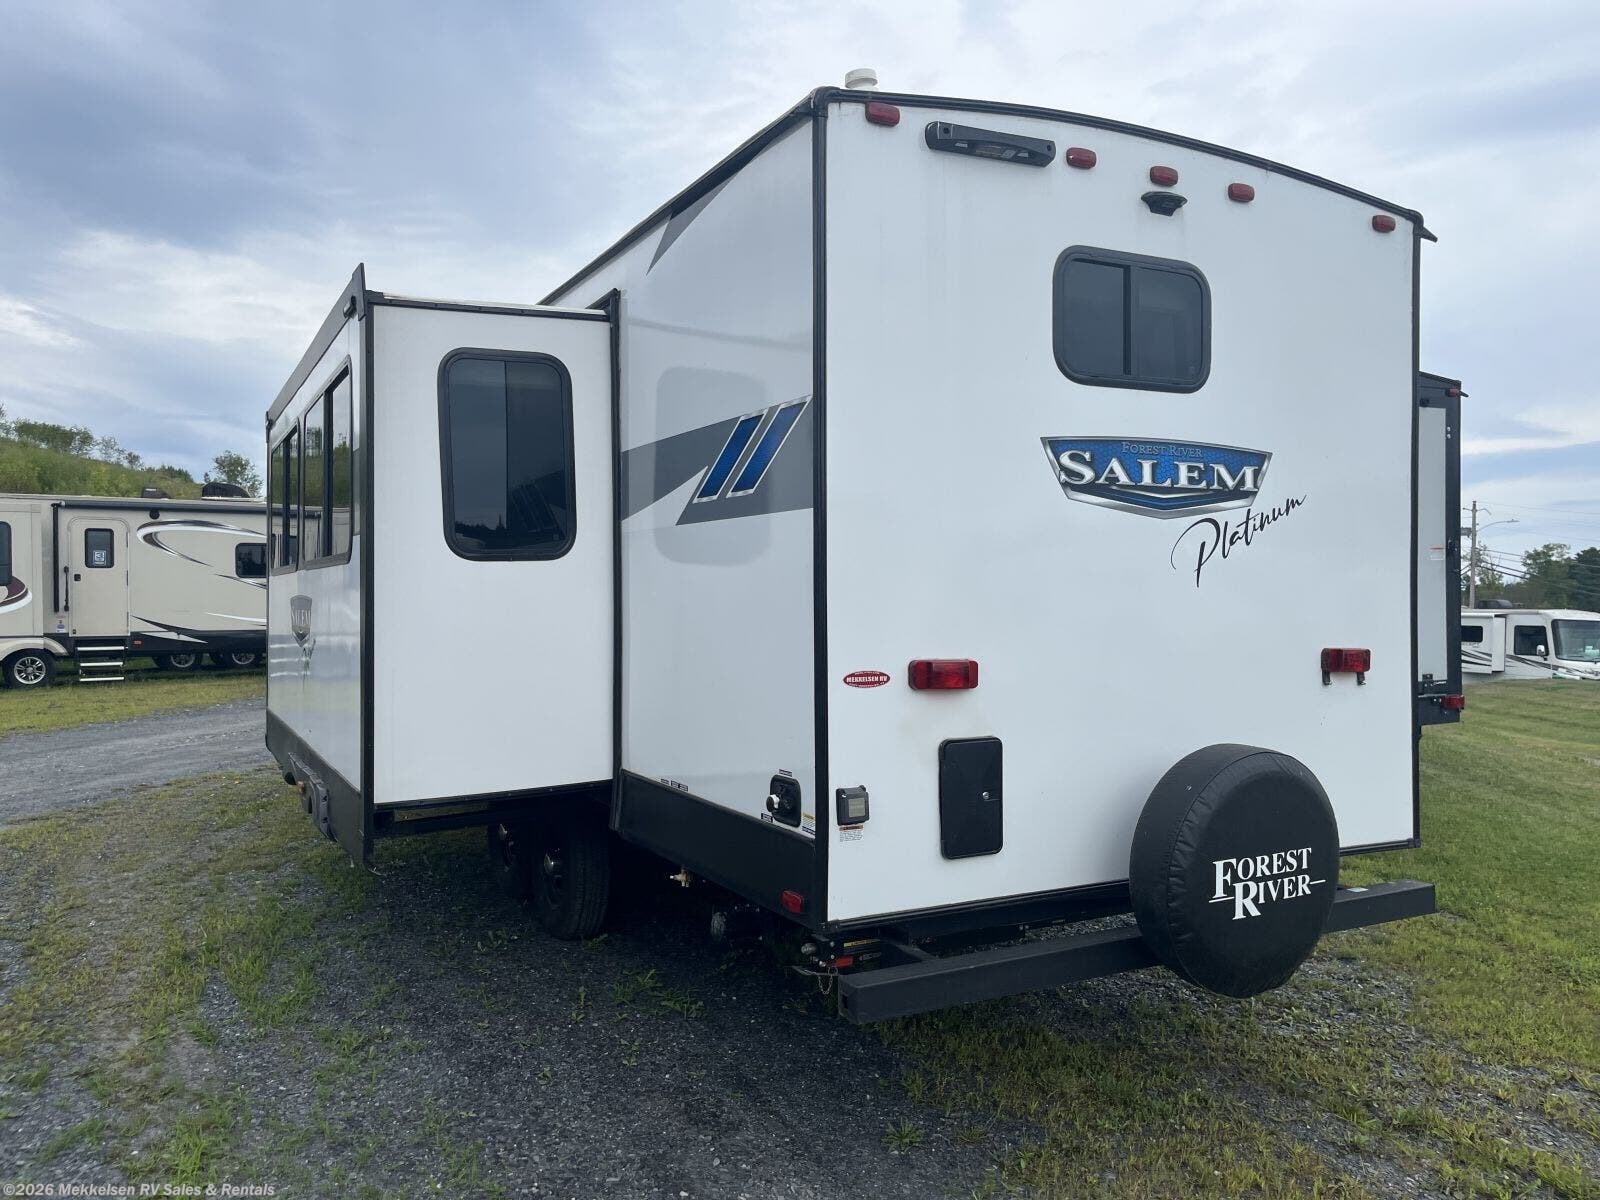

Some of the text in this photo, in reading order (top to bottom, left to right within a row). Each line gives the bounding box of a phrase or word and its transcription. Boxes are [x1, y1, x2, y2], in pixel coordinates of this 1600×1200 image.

[1058, 449, 1259, 492] SALEM
[1121, 441, 1203, 458] FOREST RIVER
[1170, 494, 1307, 588] Platinum
[1212, 847, 1312, 899] FOREST
[1232, 874, 1312, 920] RIVER
